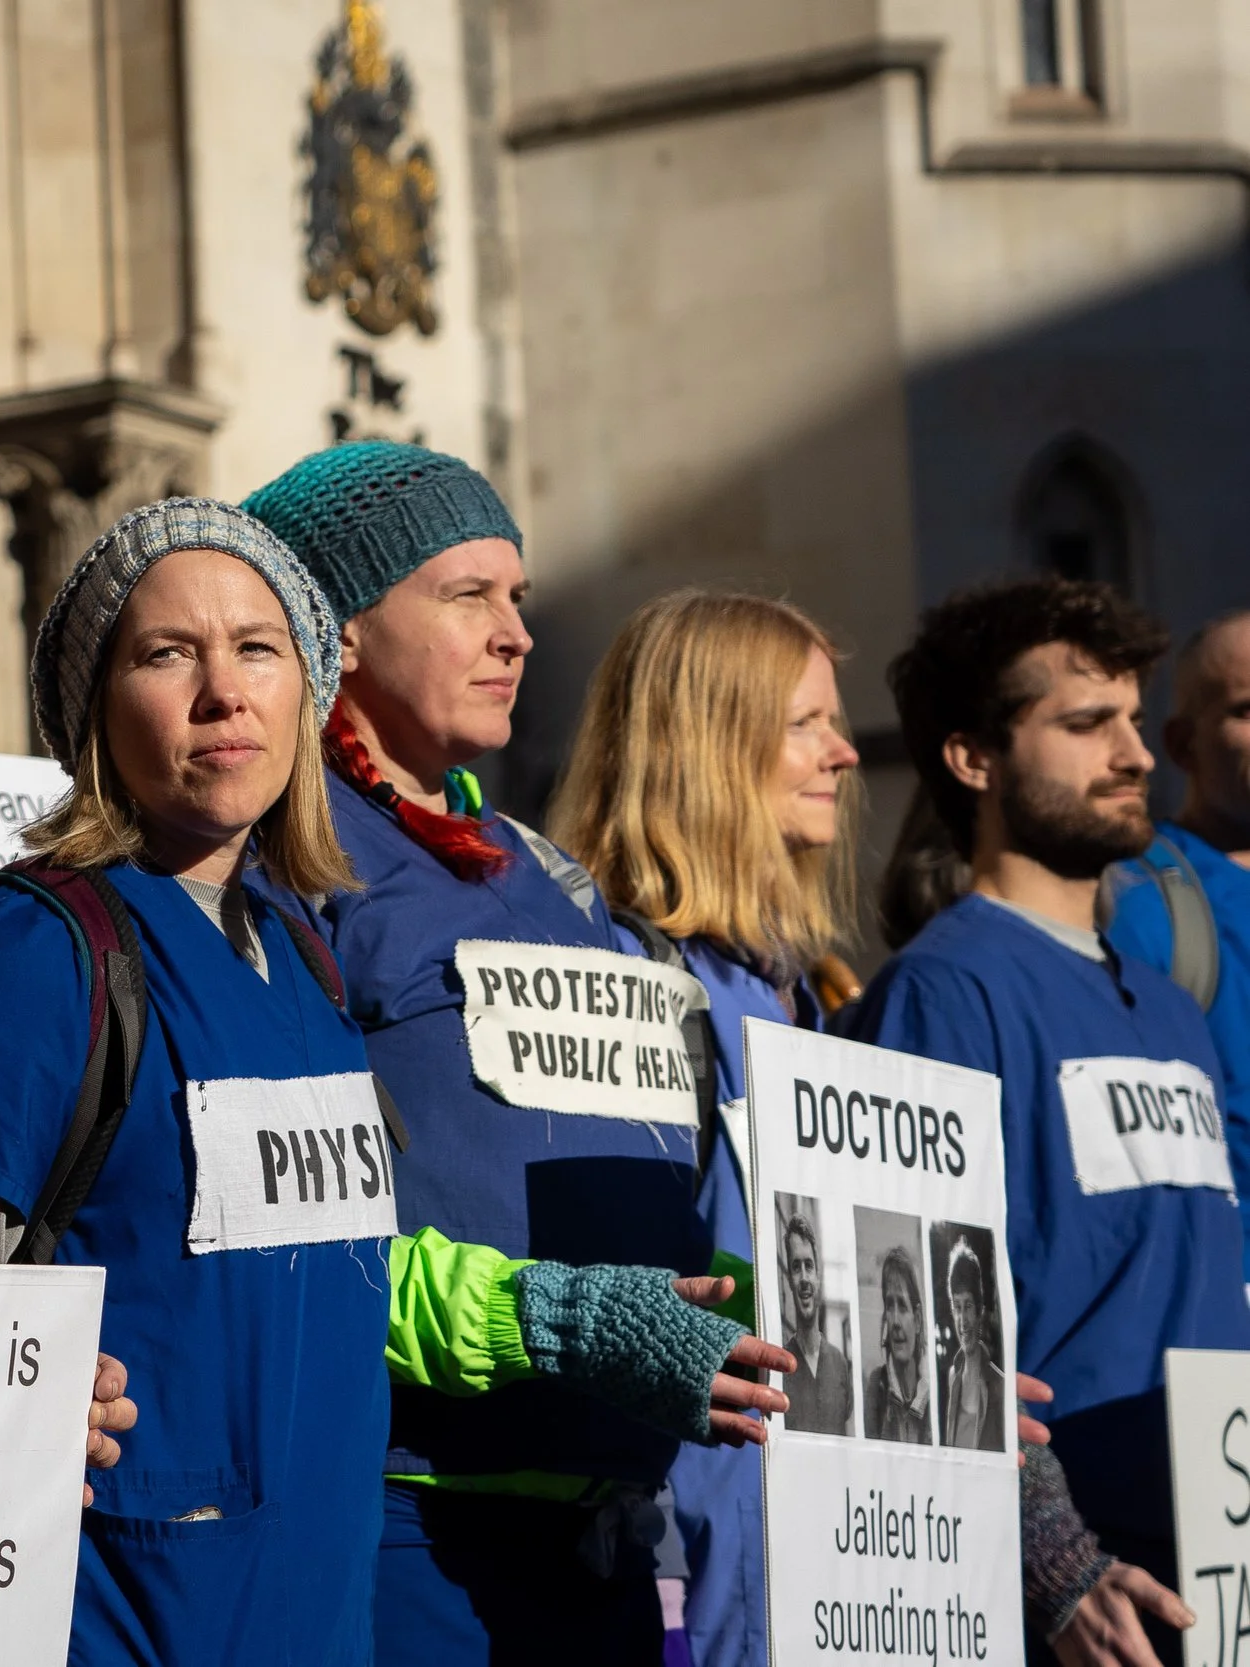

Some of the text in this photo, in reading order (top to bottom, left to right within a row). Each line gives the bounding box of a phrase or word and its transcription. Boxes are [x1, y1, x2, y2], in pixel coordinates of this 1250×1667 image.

[507, 1030, 694, 1092] PUBLIC HEAL
[257, 1123, 392, 1205] PHYSI
[793, 1077, 967, 1178] DOCTORS
[6, 1320, 41, 1386] is
[835, 1486, 962, 1564] Jailed for
[815, 1587, 987, 1667] sounding the
